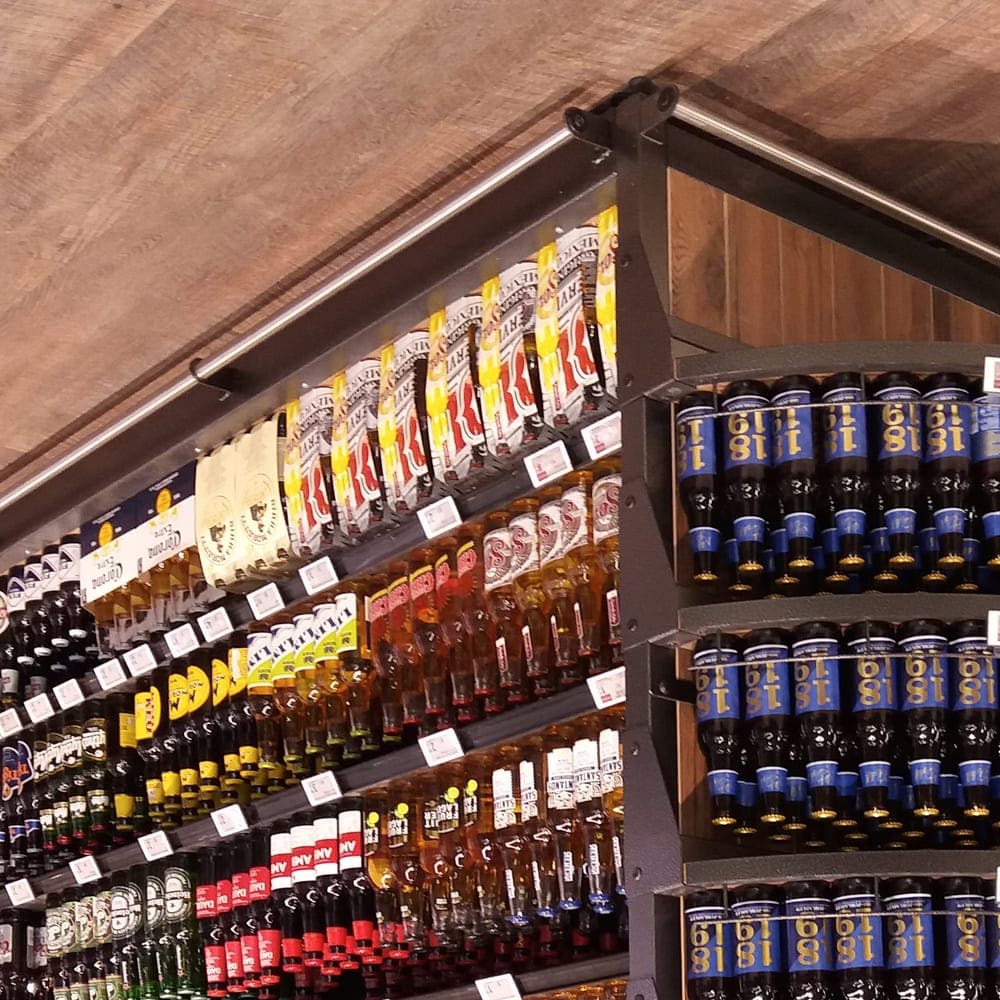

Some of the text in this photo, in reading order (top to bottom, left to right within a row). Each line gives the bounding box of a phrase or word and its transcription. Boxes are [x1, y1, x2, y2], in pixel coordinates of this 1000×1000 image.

[728, 411, 765, 435] 19
[882, 404, 918, 426] 19
[926, 403, 963, 428] 19
[729, 433, 767, 461] 18
[883, 425, 920, 452] 18
[927, 425, 965, 454] 18
[147, 529, 181, 558] Corona
[91, 563, 123, 589] Corona
[745, 661, 780, 687] 19
[795, 648, 828, 681] 19
[857, 651, 891, 678] 19
[905, 650, 943, 677] 19
[958, 651, 994, 678] 19
[695, 665, 728, 691] 19
[858, 678, 893, 705] 18
[906, 676, 944, 704] 18
[959, 678, 995, 705] 18
[696, 688, 730, 721] 18
[746, 685, 781, 713] 18
[795, 680, 830, 708] 18
[339, 840, 356, 853] AM
[271, 861, 286, 875] AM
[232, 888, 246, 898] DAU
[250, 882, 265, 891] DAU
[736, 914, 770, 942] 19
[836, 909, 872, 936] 19
[888, 904, 923, 936] 19
[690, 921, 723, 948] 19
[692, 947, 724, 974] 18
[737, 941, 771, 968] 18
[837, 935, 874, 964] 18
[889, 935, 925, 964] 18
